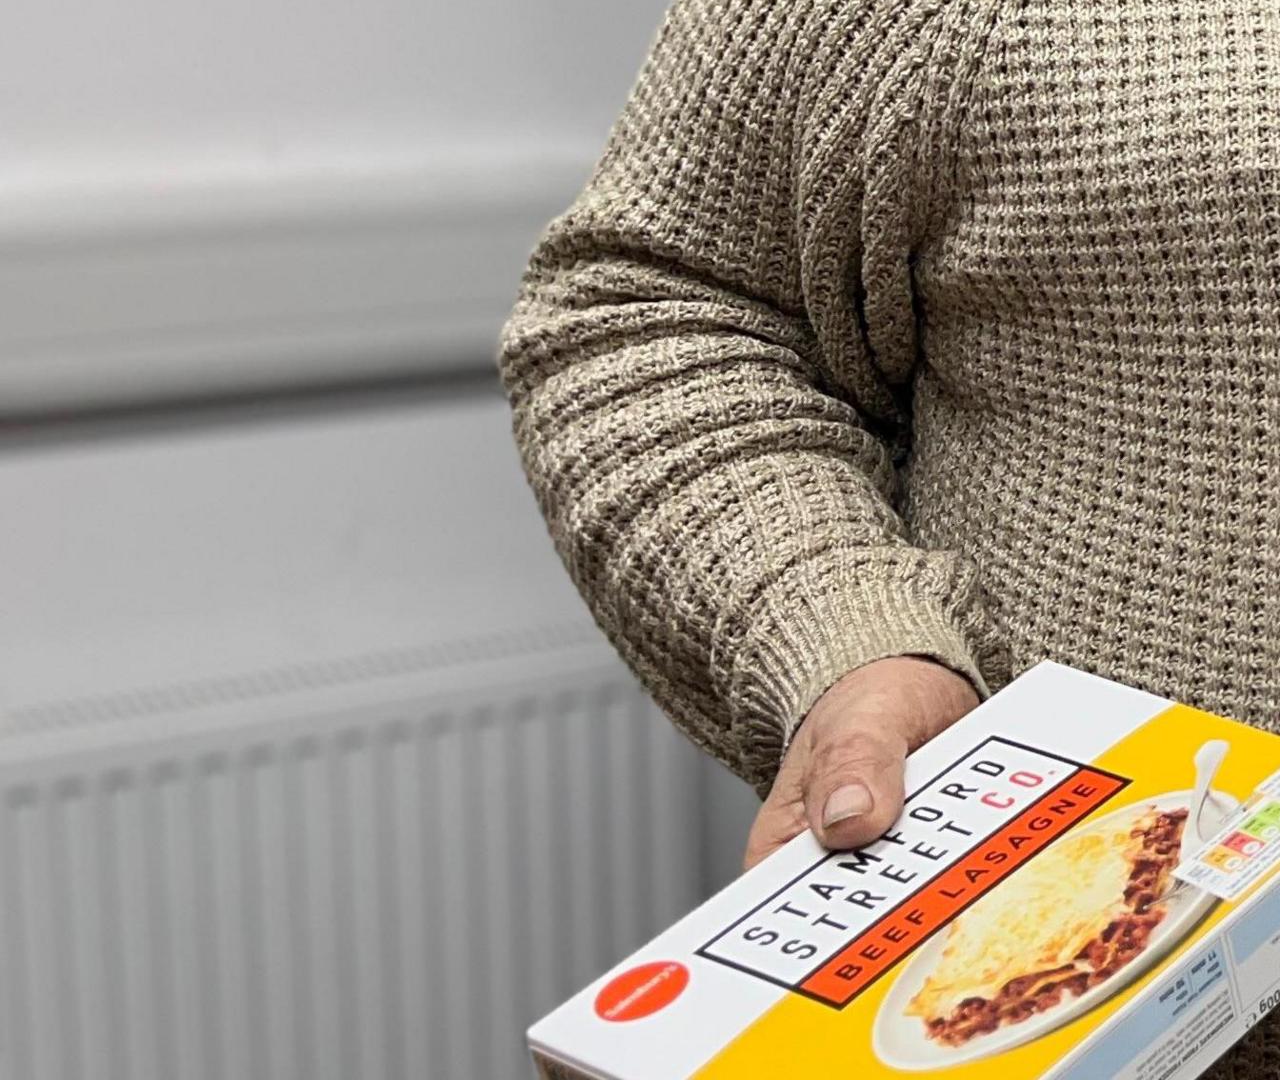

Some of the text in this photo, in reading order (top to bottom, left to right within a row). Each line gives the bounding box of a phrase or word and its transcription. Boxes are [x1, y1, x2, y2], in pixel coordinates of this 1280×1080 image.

[742, 759, 1006, 947] STAMFORD
[780, 769, 1057, 961] STREET CO.
[834, 908, 926, 981] BEEF
[938, 782, 1099, 899] LASAGNE
